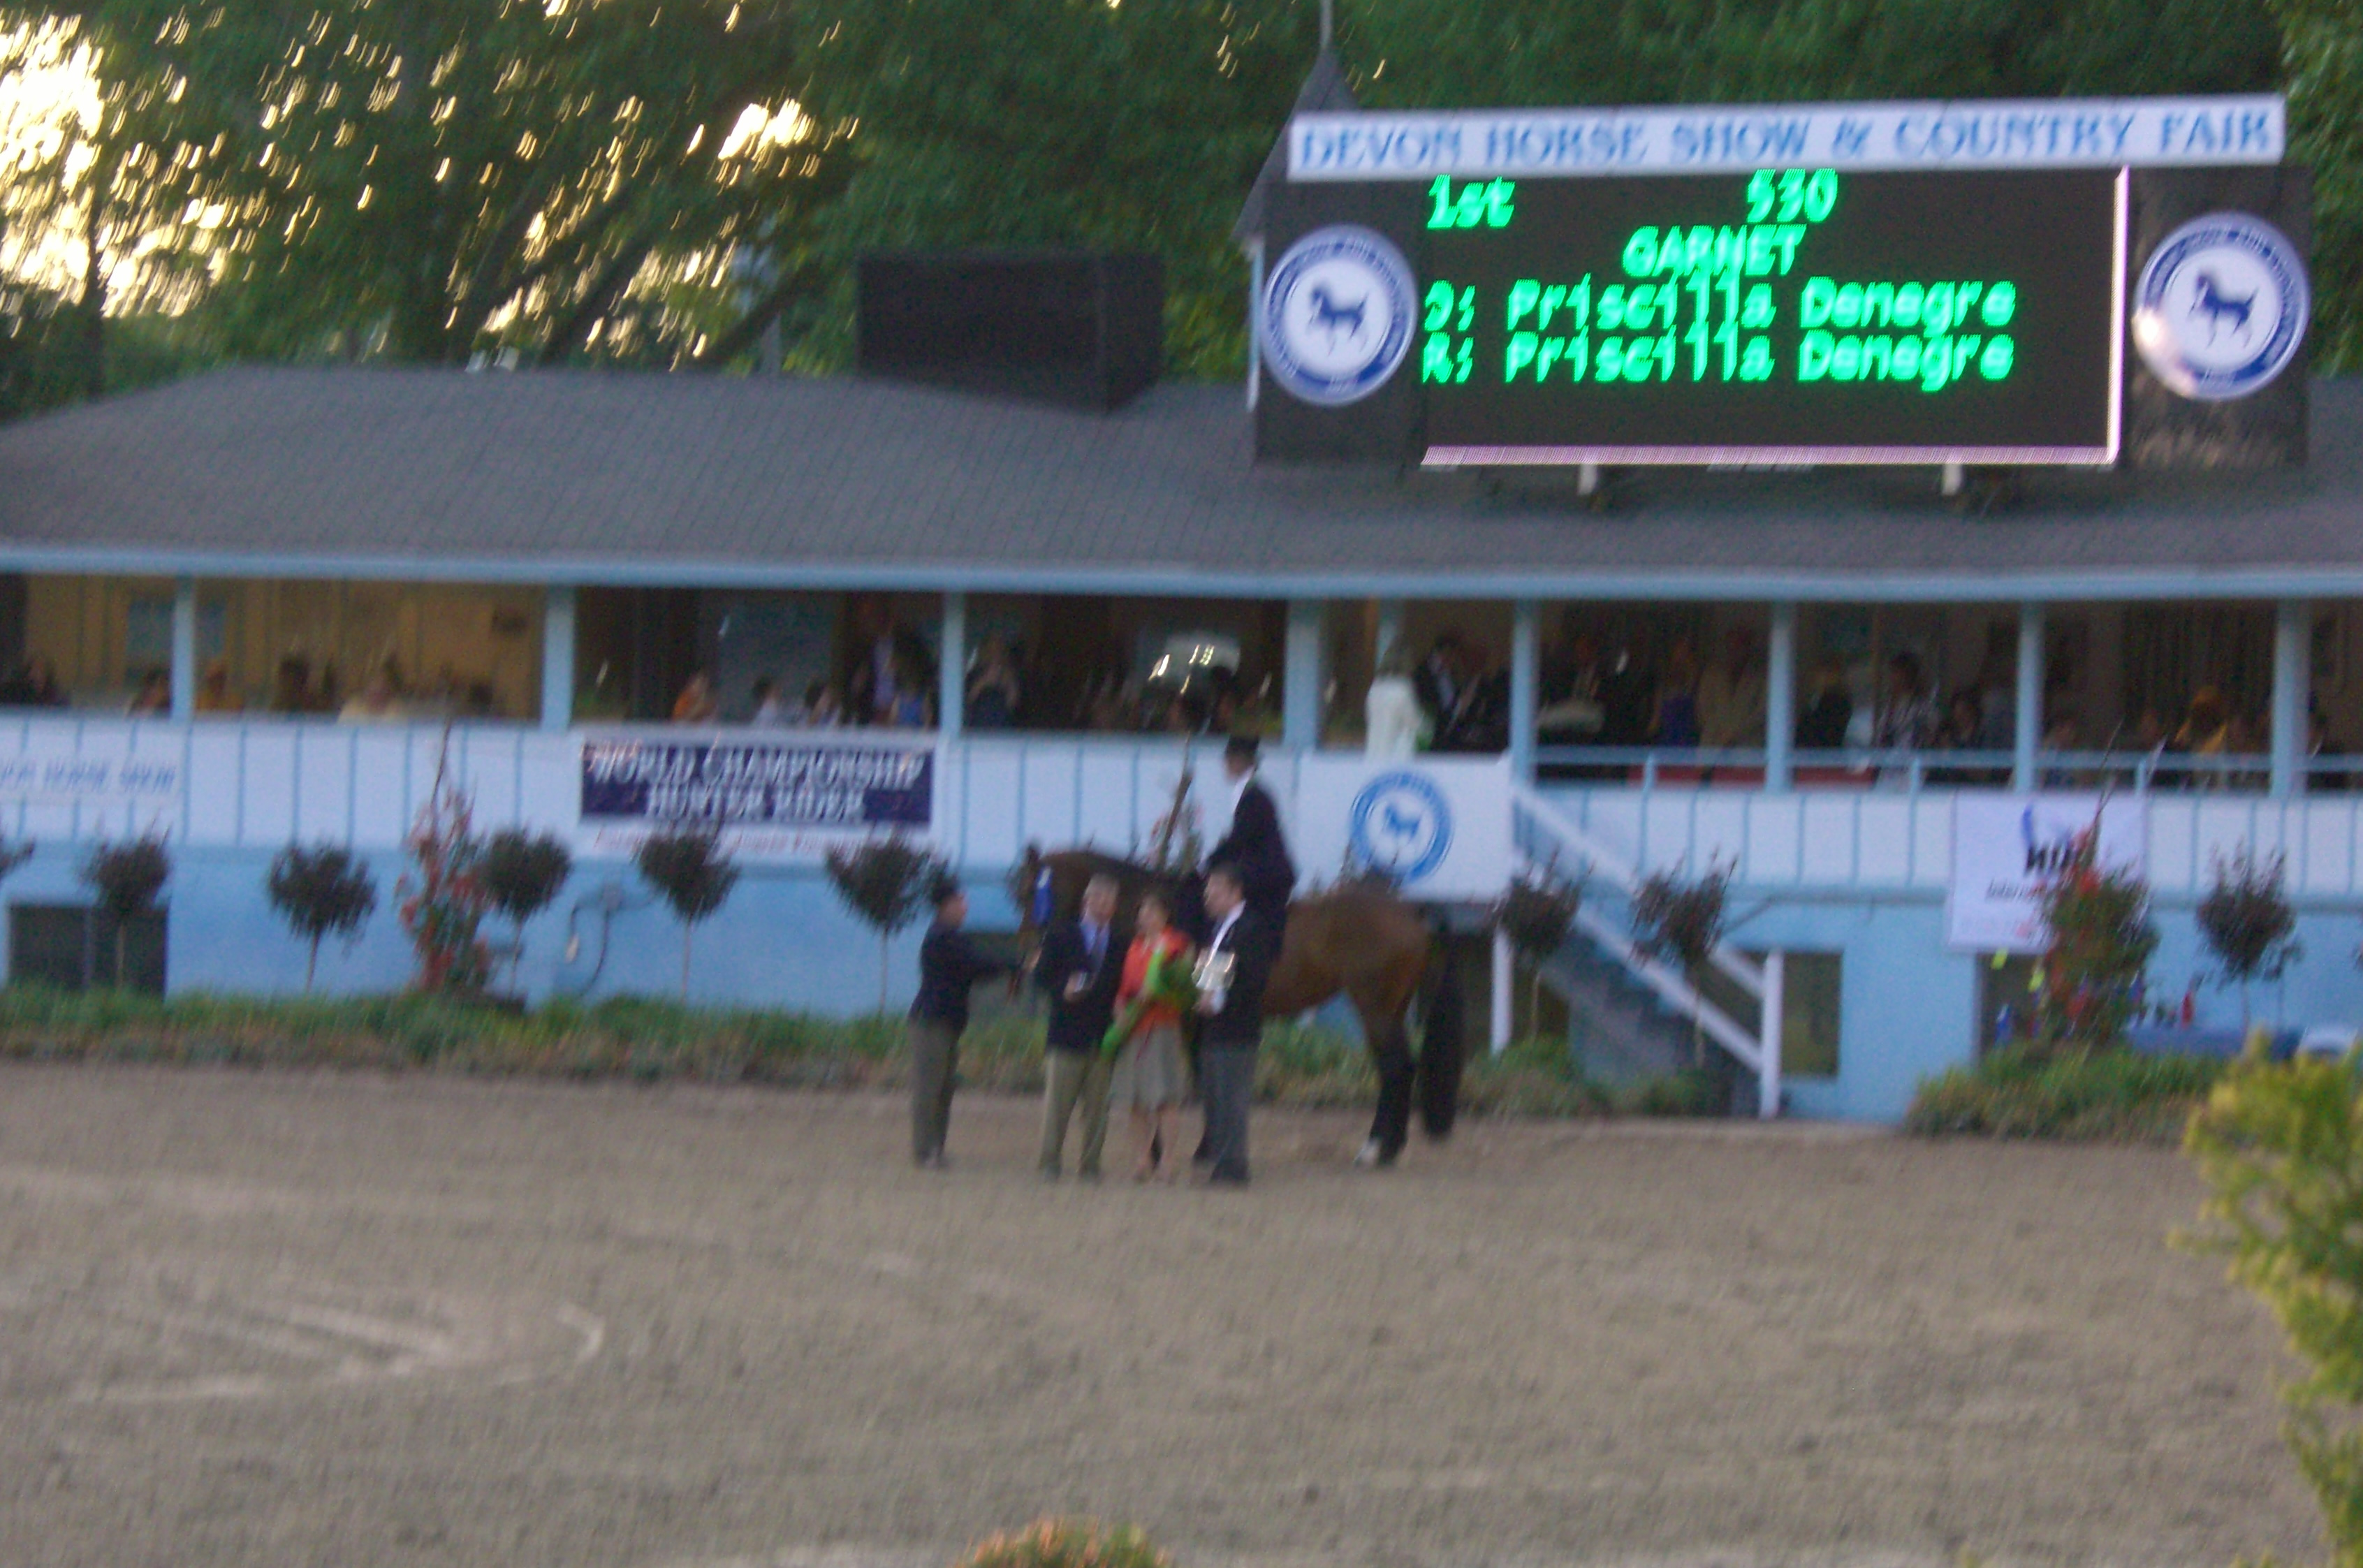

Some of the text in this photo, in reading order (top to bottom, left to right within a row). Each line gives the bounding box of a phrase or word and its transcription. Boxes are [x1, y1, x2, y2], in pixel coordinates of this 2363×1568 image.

[1299, 108, 2268, 169] DEVON HORSE SHOW & COUNTRY FAIR
[1426, 168, 1838, 229] 1st 530
[1622, 224, 1808, 277] GARNET
[1506, 271, 1777, 332] Priscilla
[1504, 324, 1776, 383] Priscilla
[585, 741, 926, 789] WORLD CHAMPIONSHIP
